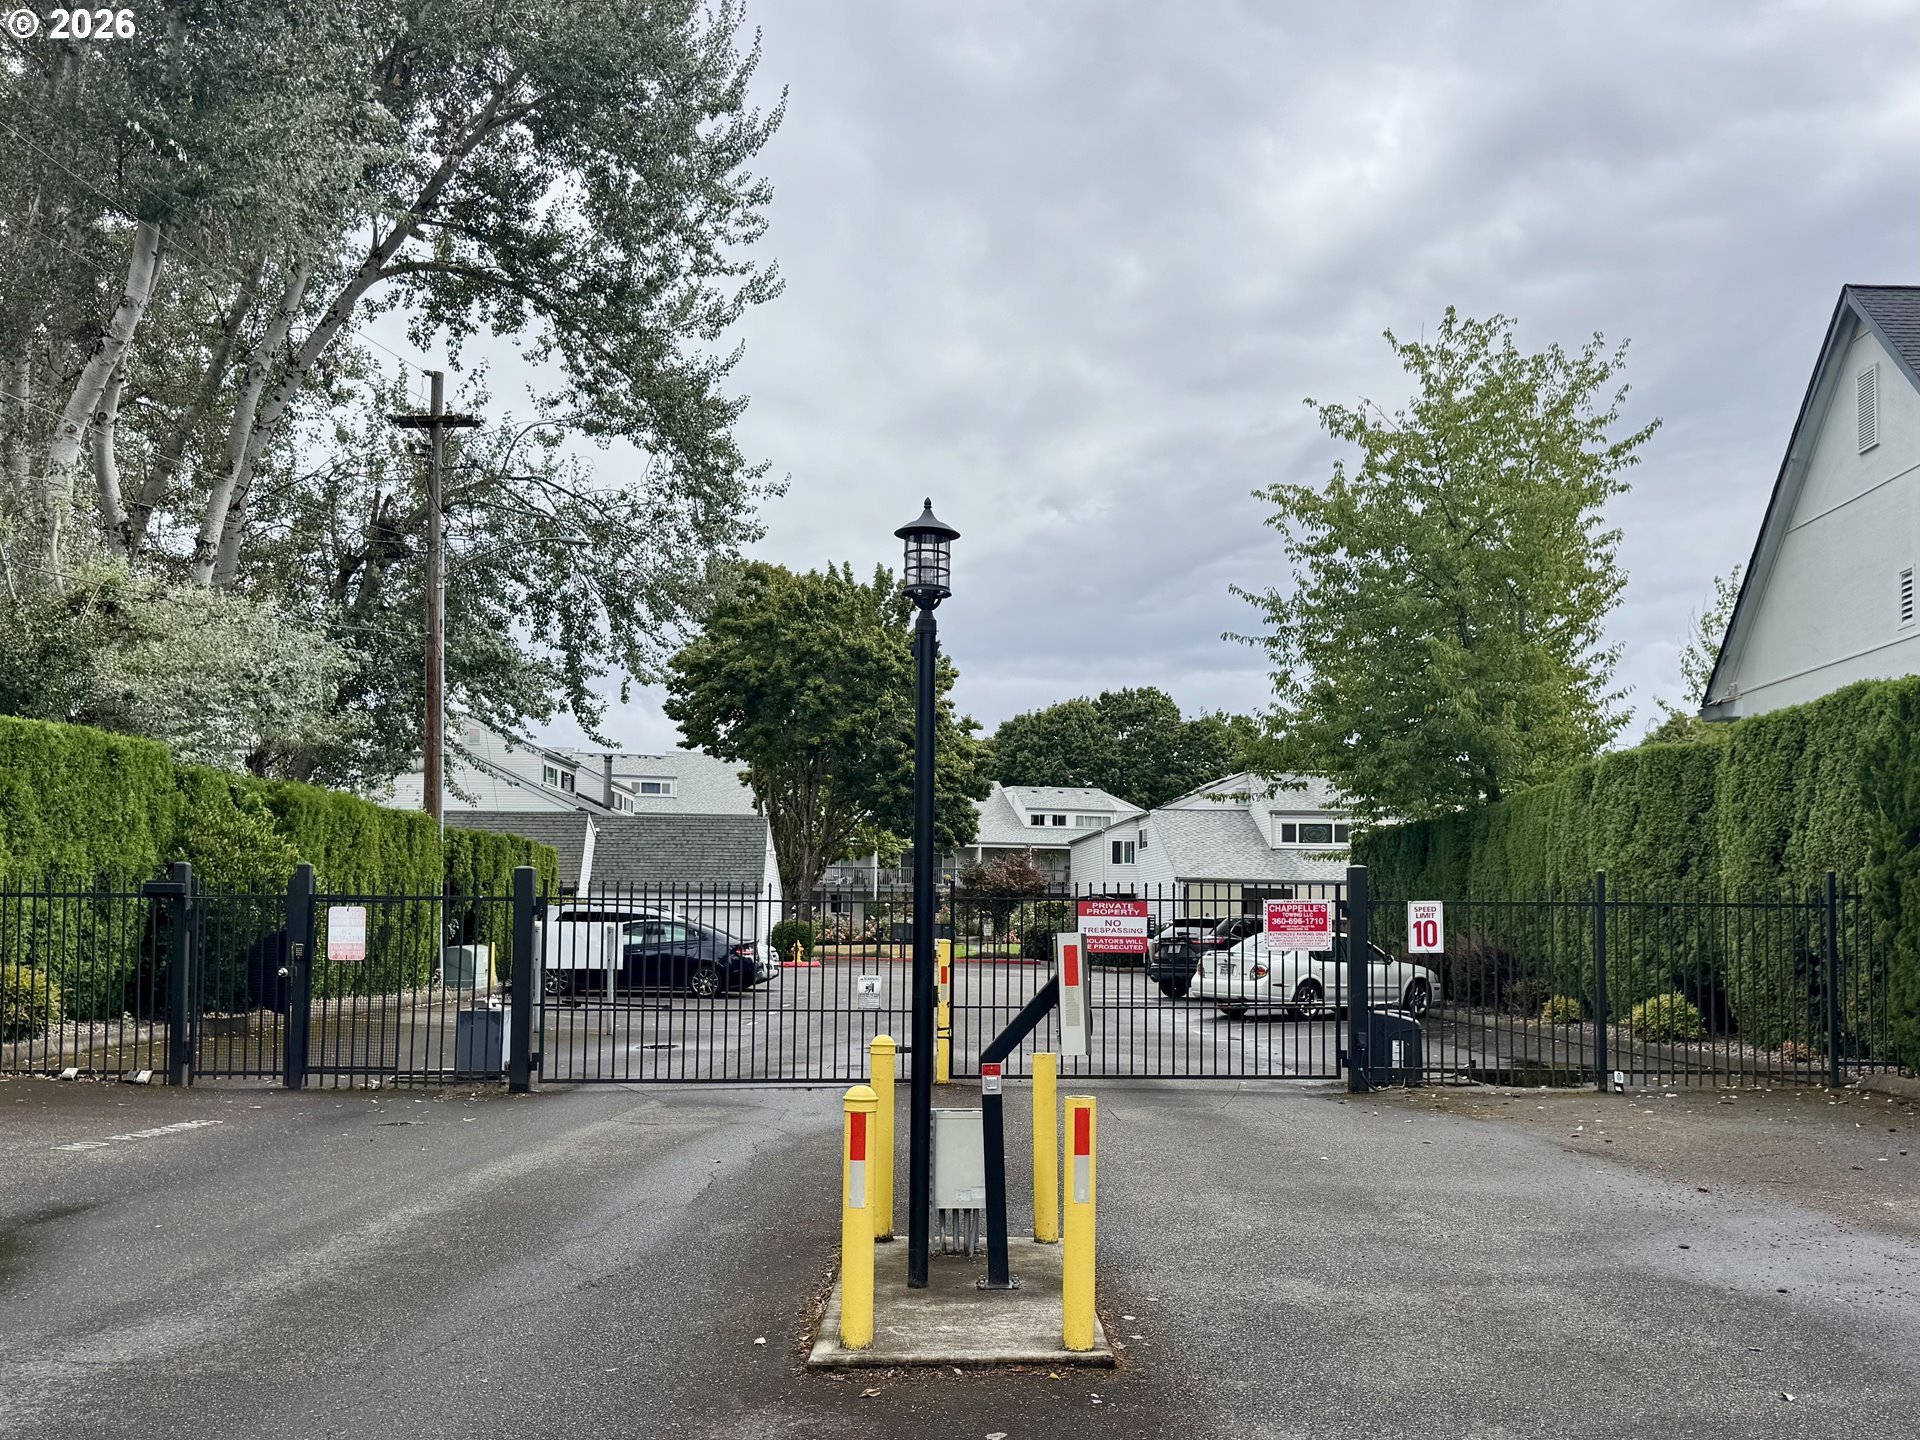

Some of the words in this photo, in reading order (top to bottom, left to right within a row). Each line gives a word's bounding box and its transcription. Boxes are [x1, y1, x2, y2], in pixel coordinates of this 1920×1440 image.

[1086, 908, 1140, 916] PROPERTY
[1268, 904, 1327, 912] CHAPPELLE'S
[1104, 919, 1122, 927] NO
[1412, 920, 1438, 947] 10
